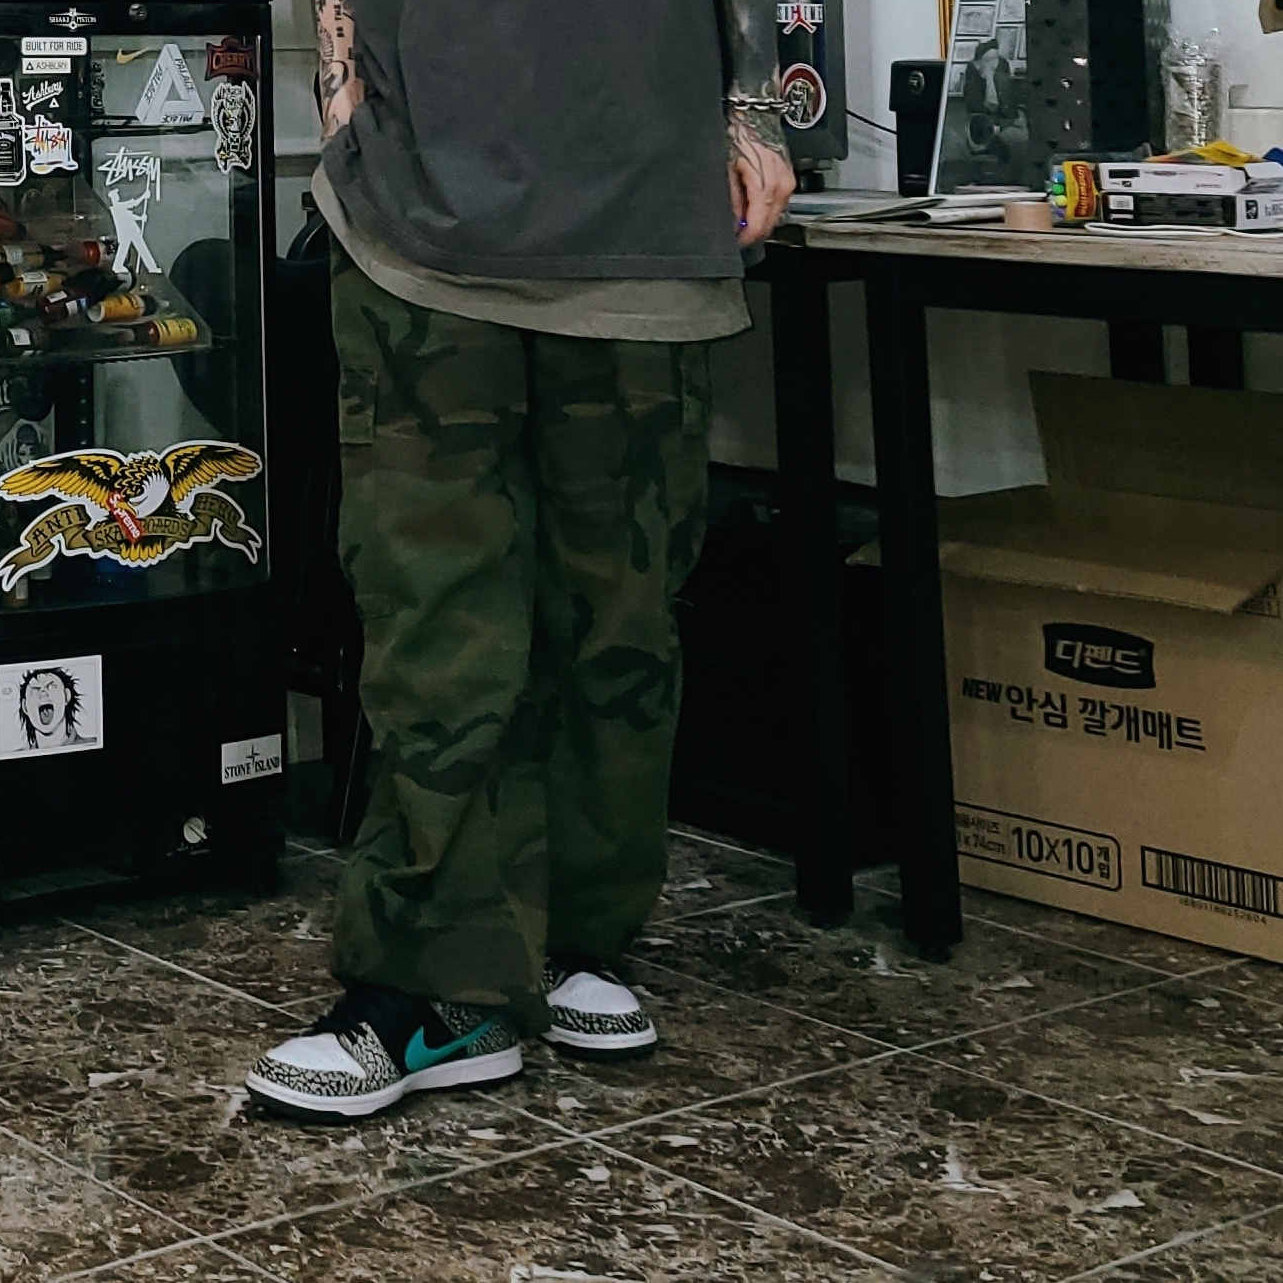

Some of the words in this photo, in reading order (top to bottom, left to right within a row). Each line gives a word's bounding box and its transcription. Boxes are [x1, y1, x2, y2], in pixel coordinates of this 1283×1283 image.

[26, 41, 48, 51] BUILT
[49, 41, 64, 51] FOR
[66, 41, 83, 51] RIDE
[36, 62, 68, 70] ASHBURY
[174, 58, 196, 92] PALACE
[22, 80, 64, 106] Ashbury
[32, 505, 86, 548] ANTI
[108, 493, 141, 539] Spreme
[94, 519, 190, 548] SKABOARDS
[1054, 638, 1144, 675] 디펜드
[962, 677, 1002, 703] NEW
[1005, 684, 1069, 730] 안심
[1077, 696, 1207, 752] 깔개매트
[224, 762, 251, 780] STONE
[254, 755, 281, 772] ISLAND
